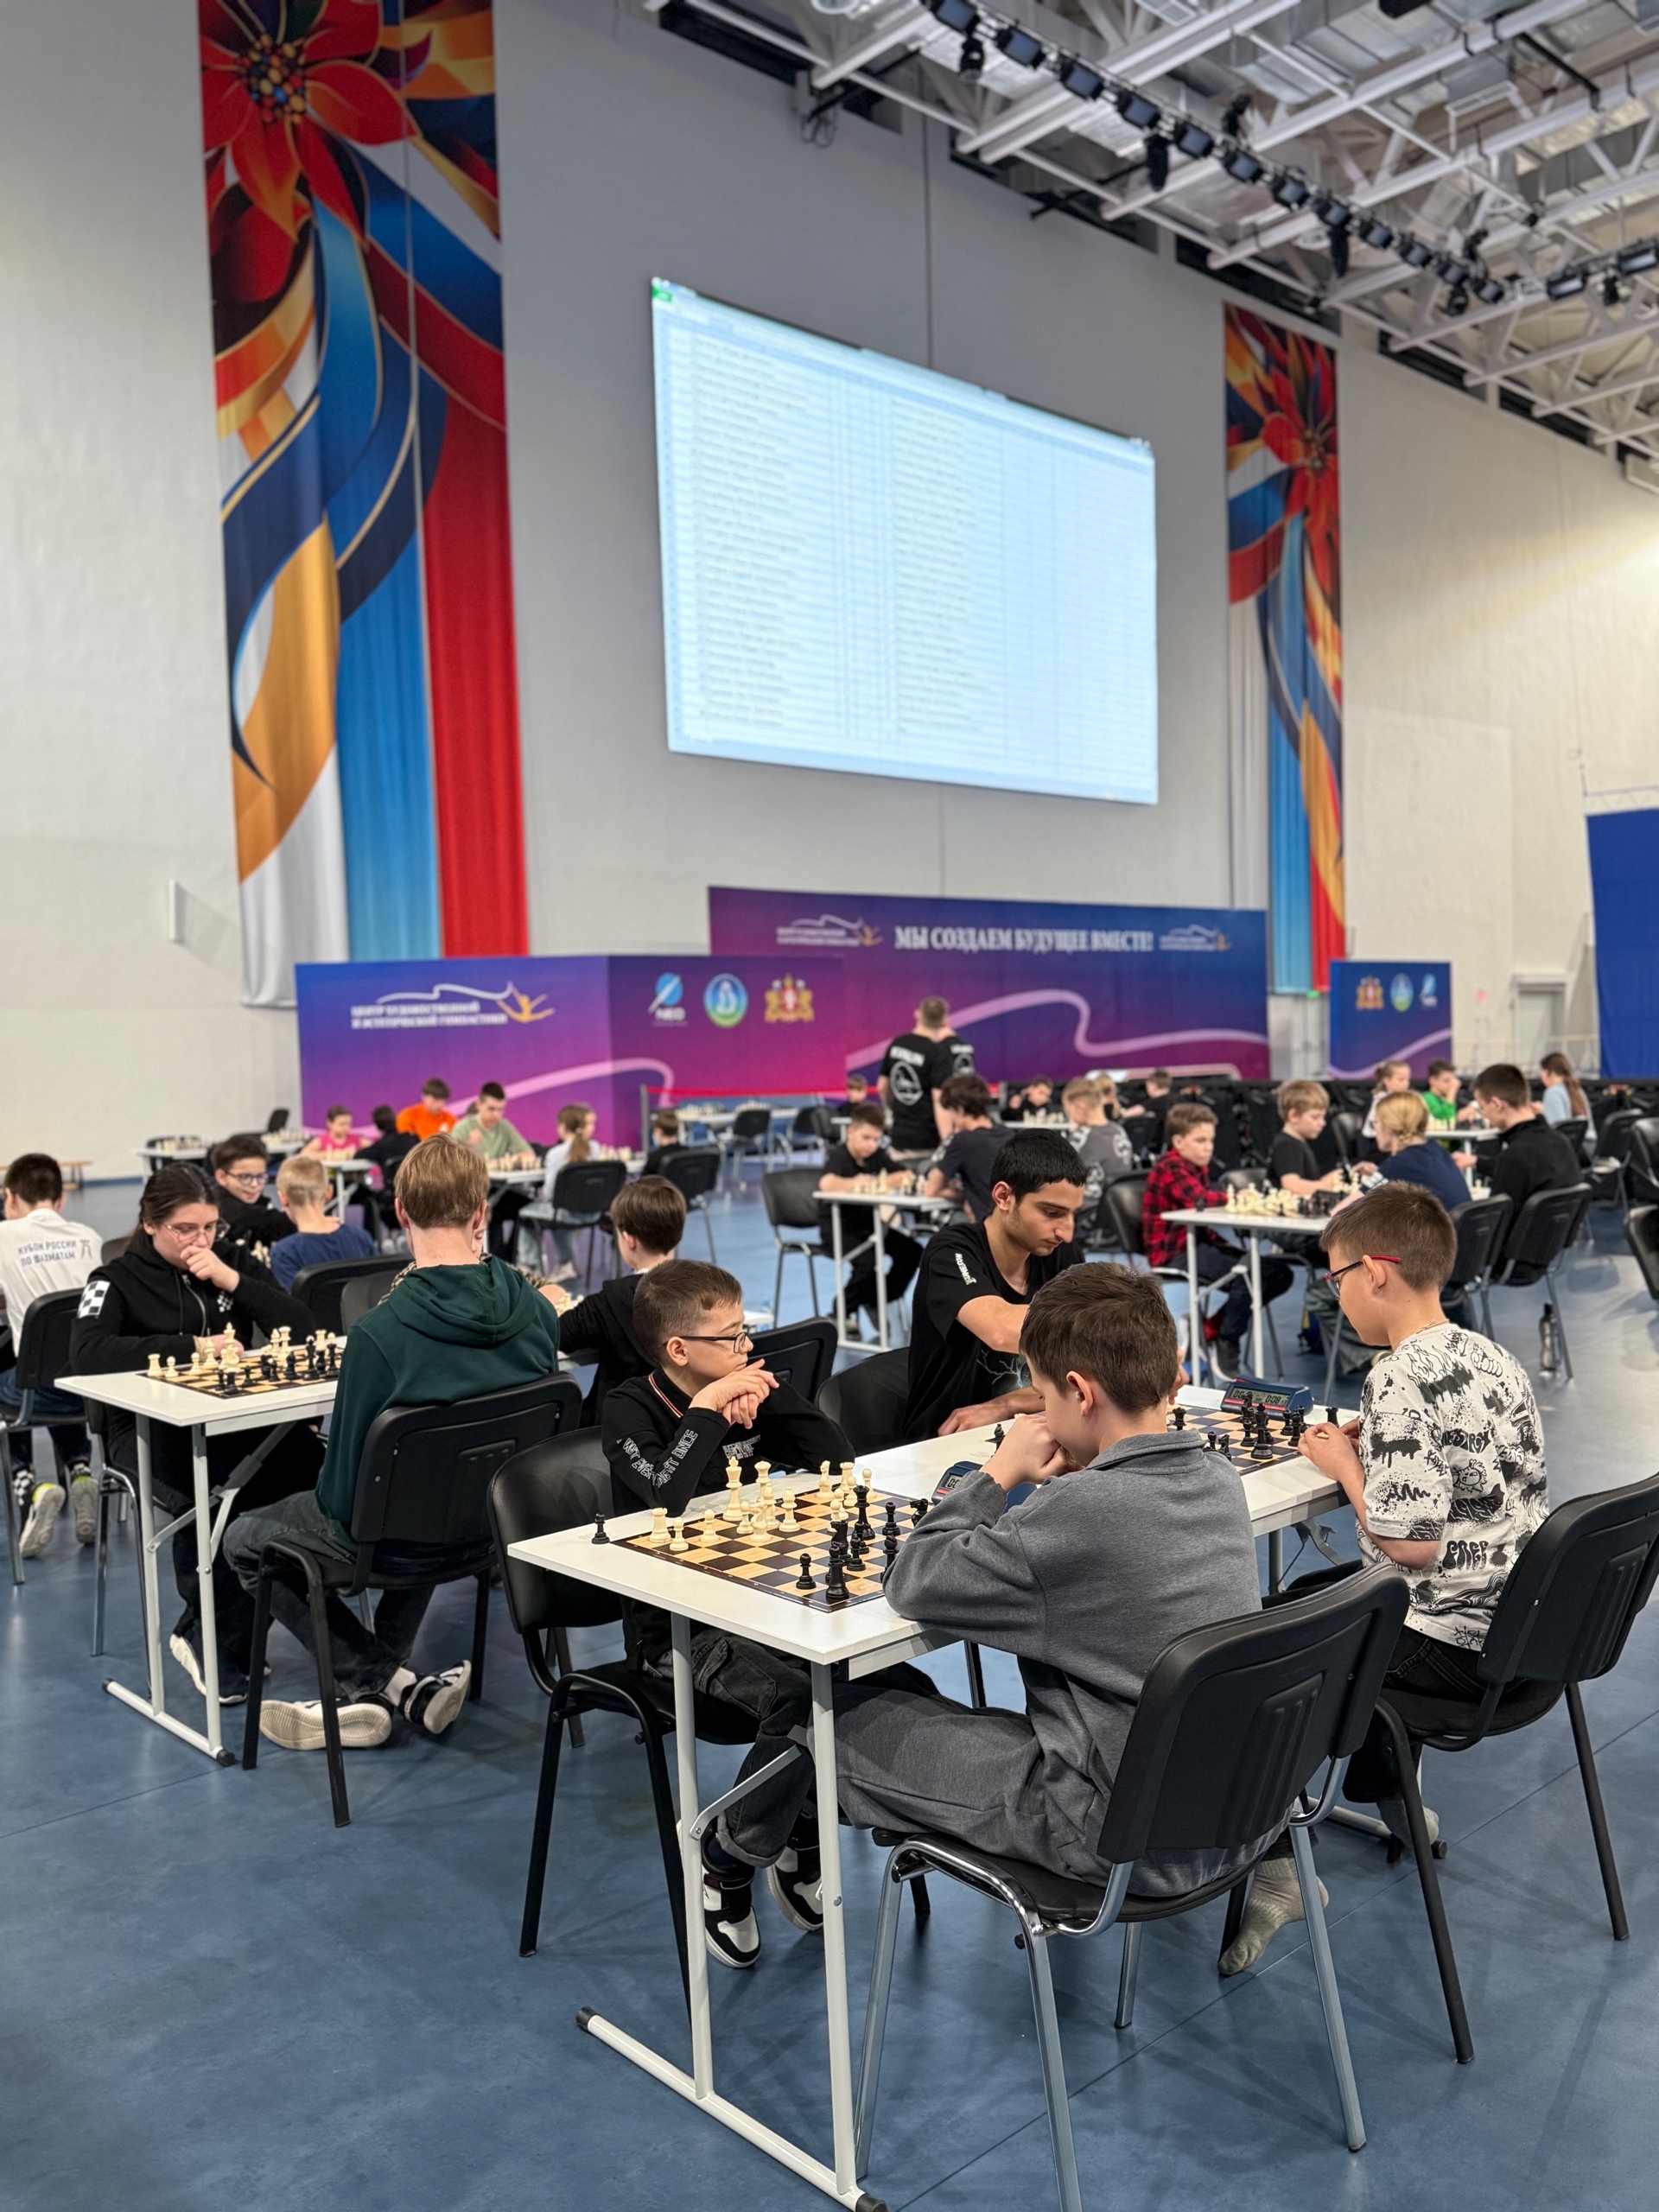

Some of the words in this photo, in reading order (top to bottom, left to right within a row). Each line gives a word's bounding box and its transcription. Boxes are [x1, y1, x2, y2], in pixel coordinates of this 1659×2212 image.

[894, 925, 928, 950] МЫ
[18, 1243, 44, 1255] КУБОК
[46, 1240, 76, 1249] РОССИИ
[21, 1256, 32, 1266] ПО
[34, 1252, 75, 1262] ШАХМАТАМ
[671, 1429, 698, 1459] ONCE
[1442, 1540, 1489, 1571] FREE
